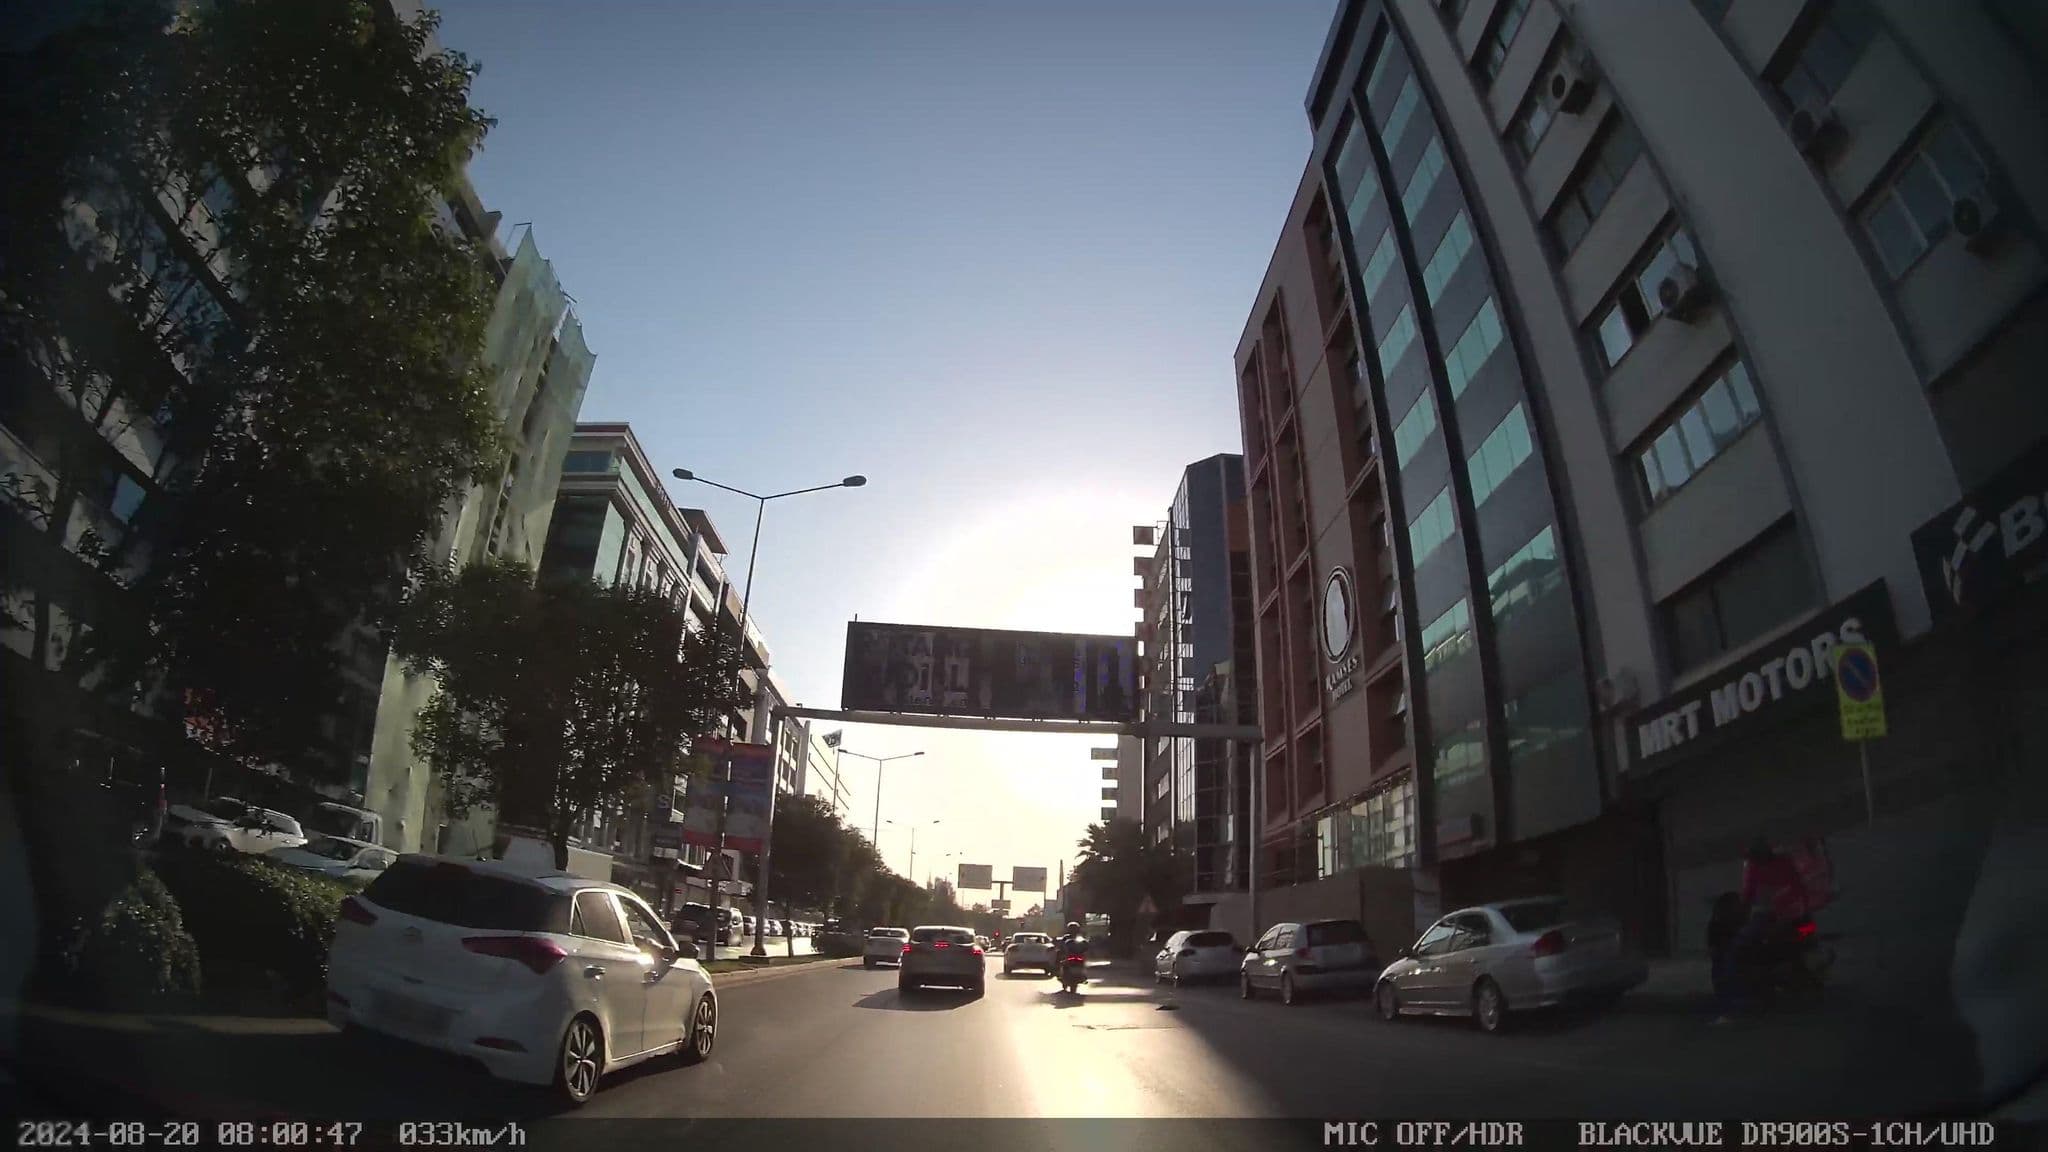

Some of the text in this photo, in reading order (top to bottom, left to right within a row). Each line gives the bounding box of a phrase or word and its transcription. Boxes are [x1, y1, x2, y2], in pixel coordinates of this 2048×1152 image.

[2000, 491, 2048, 559] B
[1638, 702, 1701, 758] MRT
[1711, 617, 1866, 726] MOTORS
